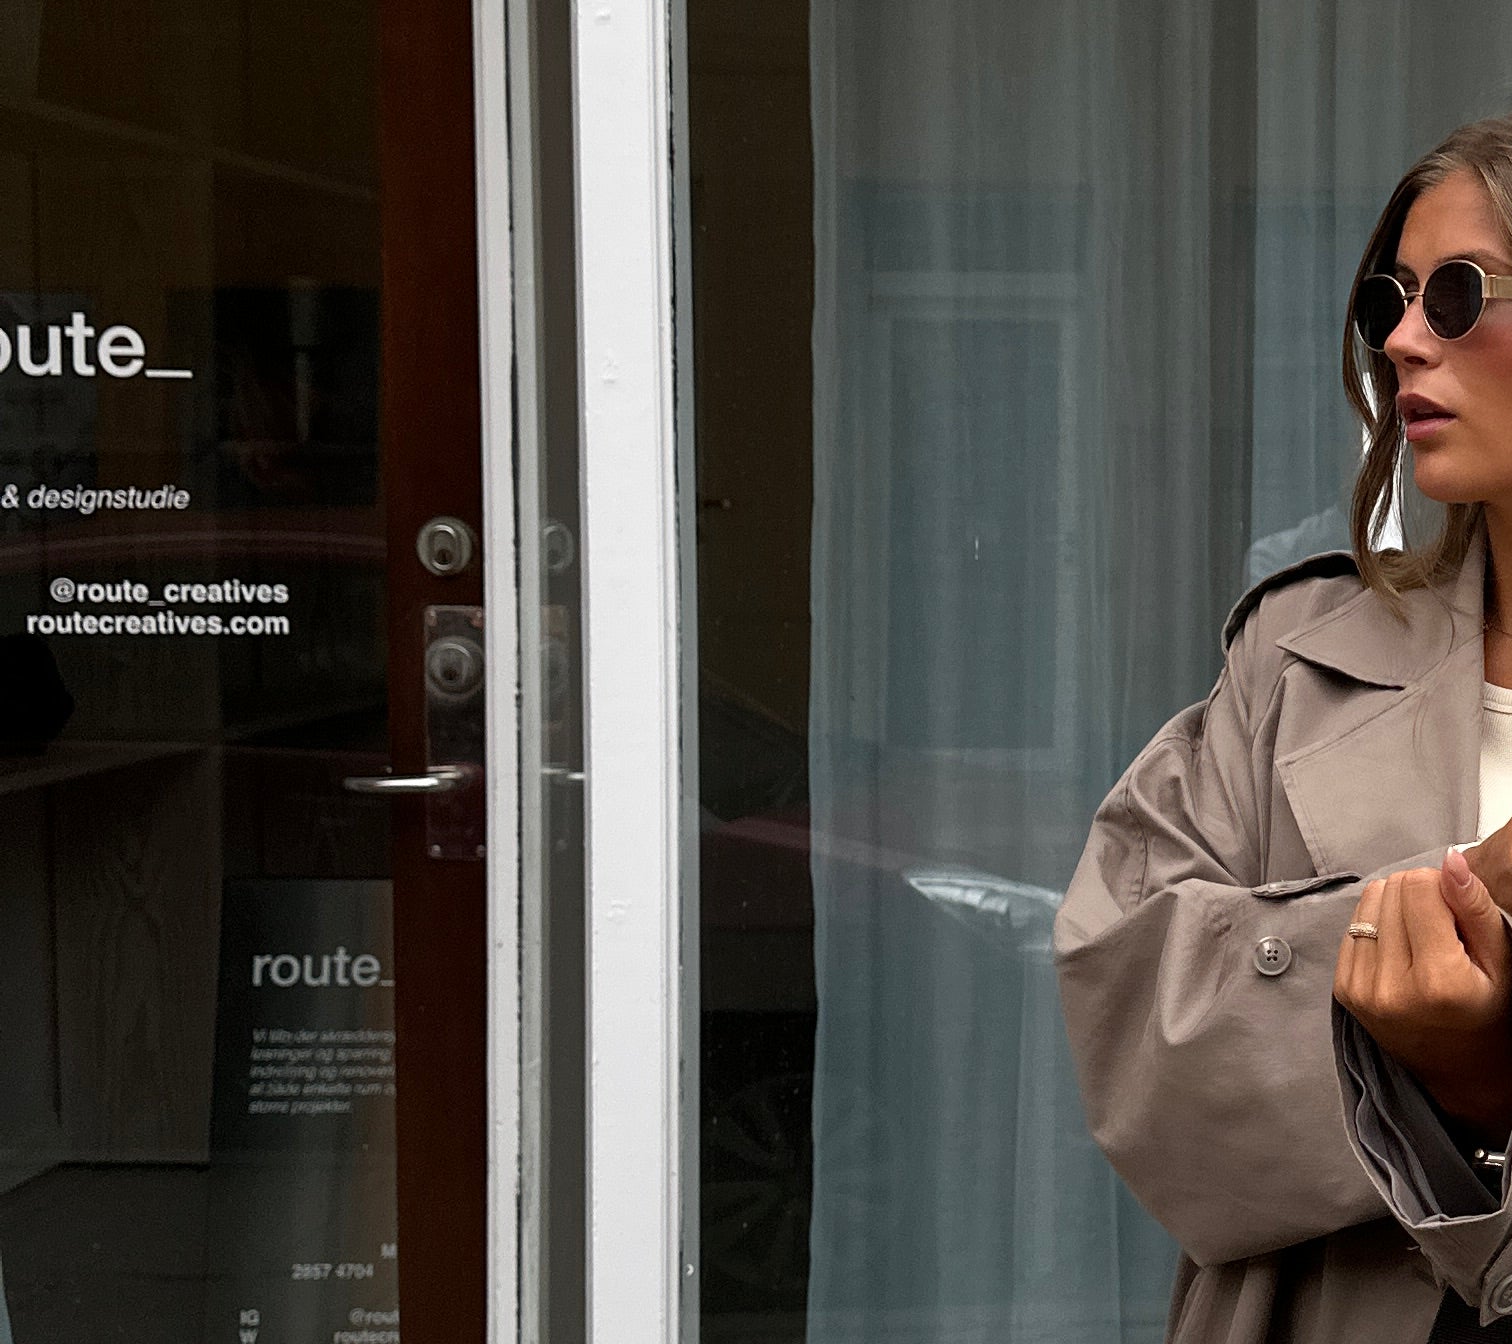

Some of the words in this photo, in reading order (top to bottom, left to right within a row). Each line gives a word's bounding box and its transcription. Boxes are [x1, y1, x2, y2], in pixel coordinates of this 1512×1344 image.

[0, 312, 193, 378] ute_
[1, 483, 19, 509] &
[27, 484, 190, 515] designstudie
[50, 577, 289, 606] @route_creatives
[27, 610, 290, 635] routecreatives.com
